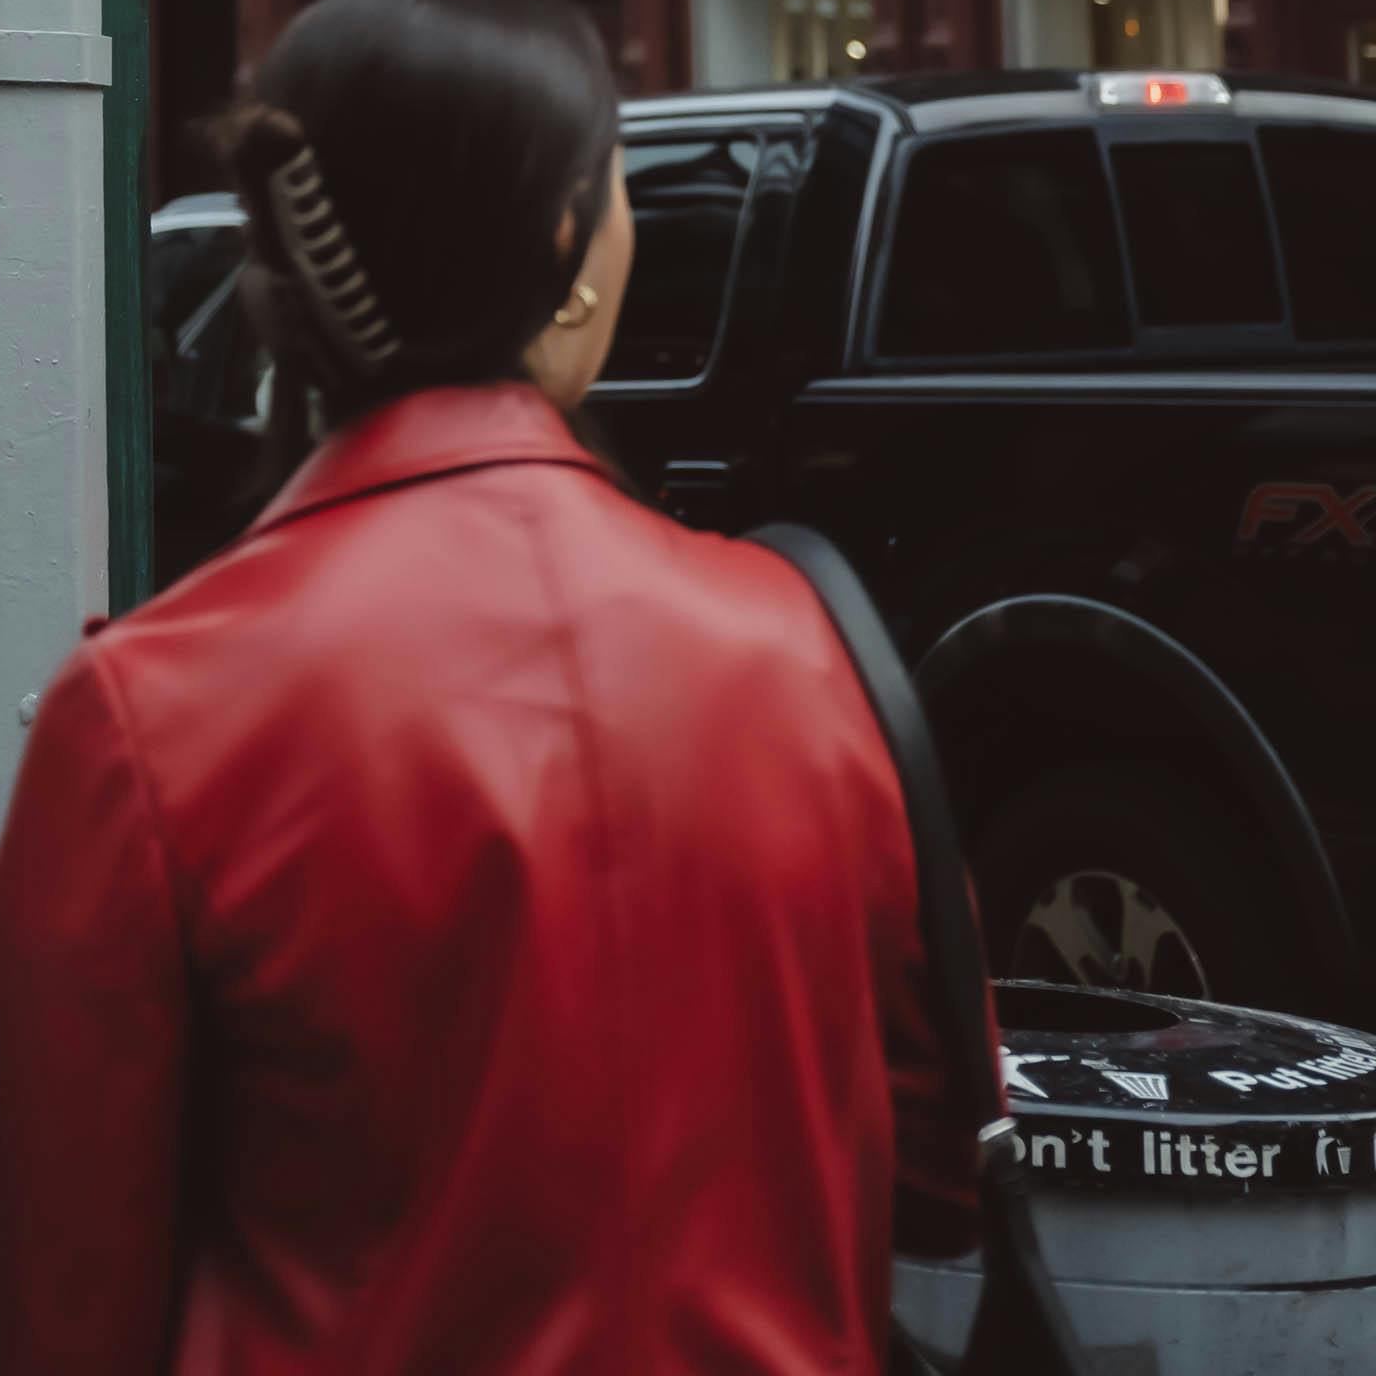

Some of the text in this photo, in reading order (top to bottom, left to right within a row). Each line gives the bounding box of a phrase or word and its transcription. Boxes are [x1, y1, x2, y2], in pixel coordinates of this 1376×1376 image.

[1237, 481, 1376, 546] FX
[1208, 1068, 1328, 1092] Put
[1143, 1130, 1281, 1178] litter
